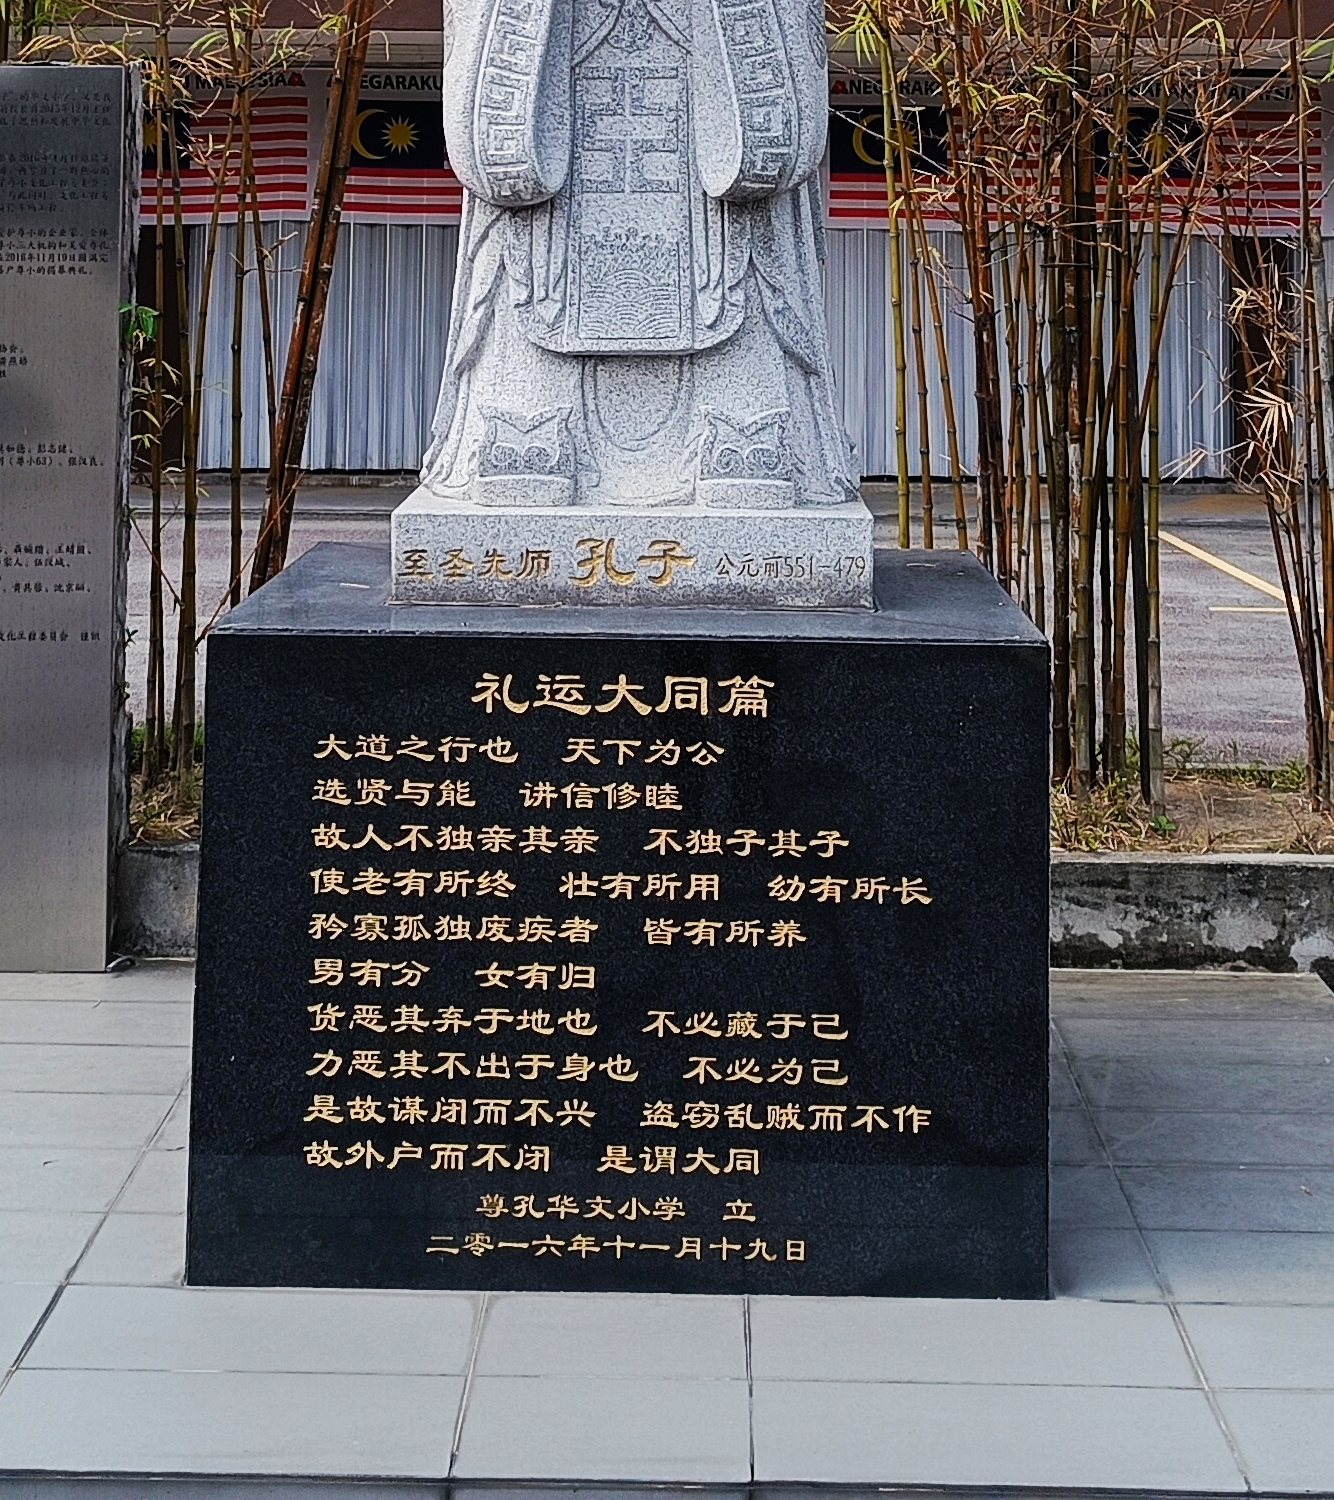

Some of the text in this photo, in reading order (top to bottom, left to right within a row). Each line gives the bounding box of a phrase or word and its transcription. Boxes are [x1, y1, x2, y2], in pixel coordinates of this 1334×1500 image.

[195, 71, 288, 89] MALSIA
[350, 73, 443, 91] EGARAKU
[849, 79, 943, 96] NEGRAK
[397, 537, 867, 587] 至圣先师 孔子 公元前551-479
[470, 672, 775, 718] 礼运大同篇
[313, 733, 725, 766] 大道之行也 天下为公
[311, 778, 683, 811] 选贤与能 讲信修睦
[310, 822, 850, 858] 故人不独亲其亲 不独子其子
[309, 866, 933, 905] 使老有所终 壮有所用 幼有所长
[307, 912, 807, 948] 矜寡孤独废疾者 皆有所养
[308, 958, 596, 991] 男有分 女有归
[306, 1002, 849, 1041] 货恶其弃于地也 不必藏于己
[305, 1048, 849, 1086] 力恶其不出于身也 不必为己
[302, 1094, 932, 1134] 是故谋闭而不兴 盗窃乱贼而不作
[302, 1139, 760, 1176] 故外户而不闭 是谓大同
[475, 1193, 757, 1223] 尊孔华文小学 立
[425, 1232, 805, 1262] 二零一六年十一月十九日
